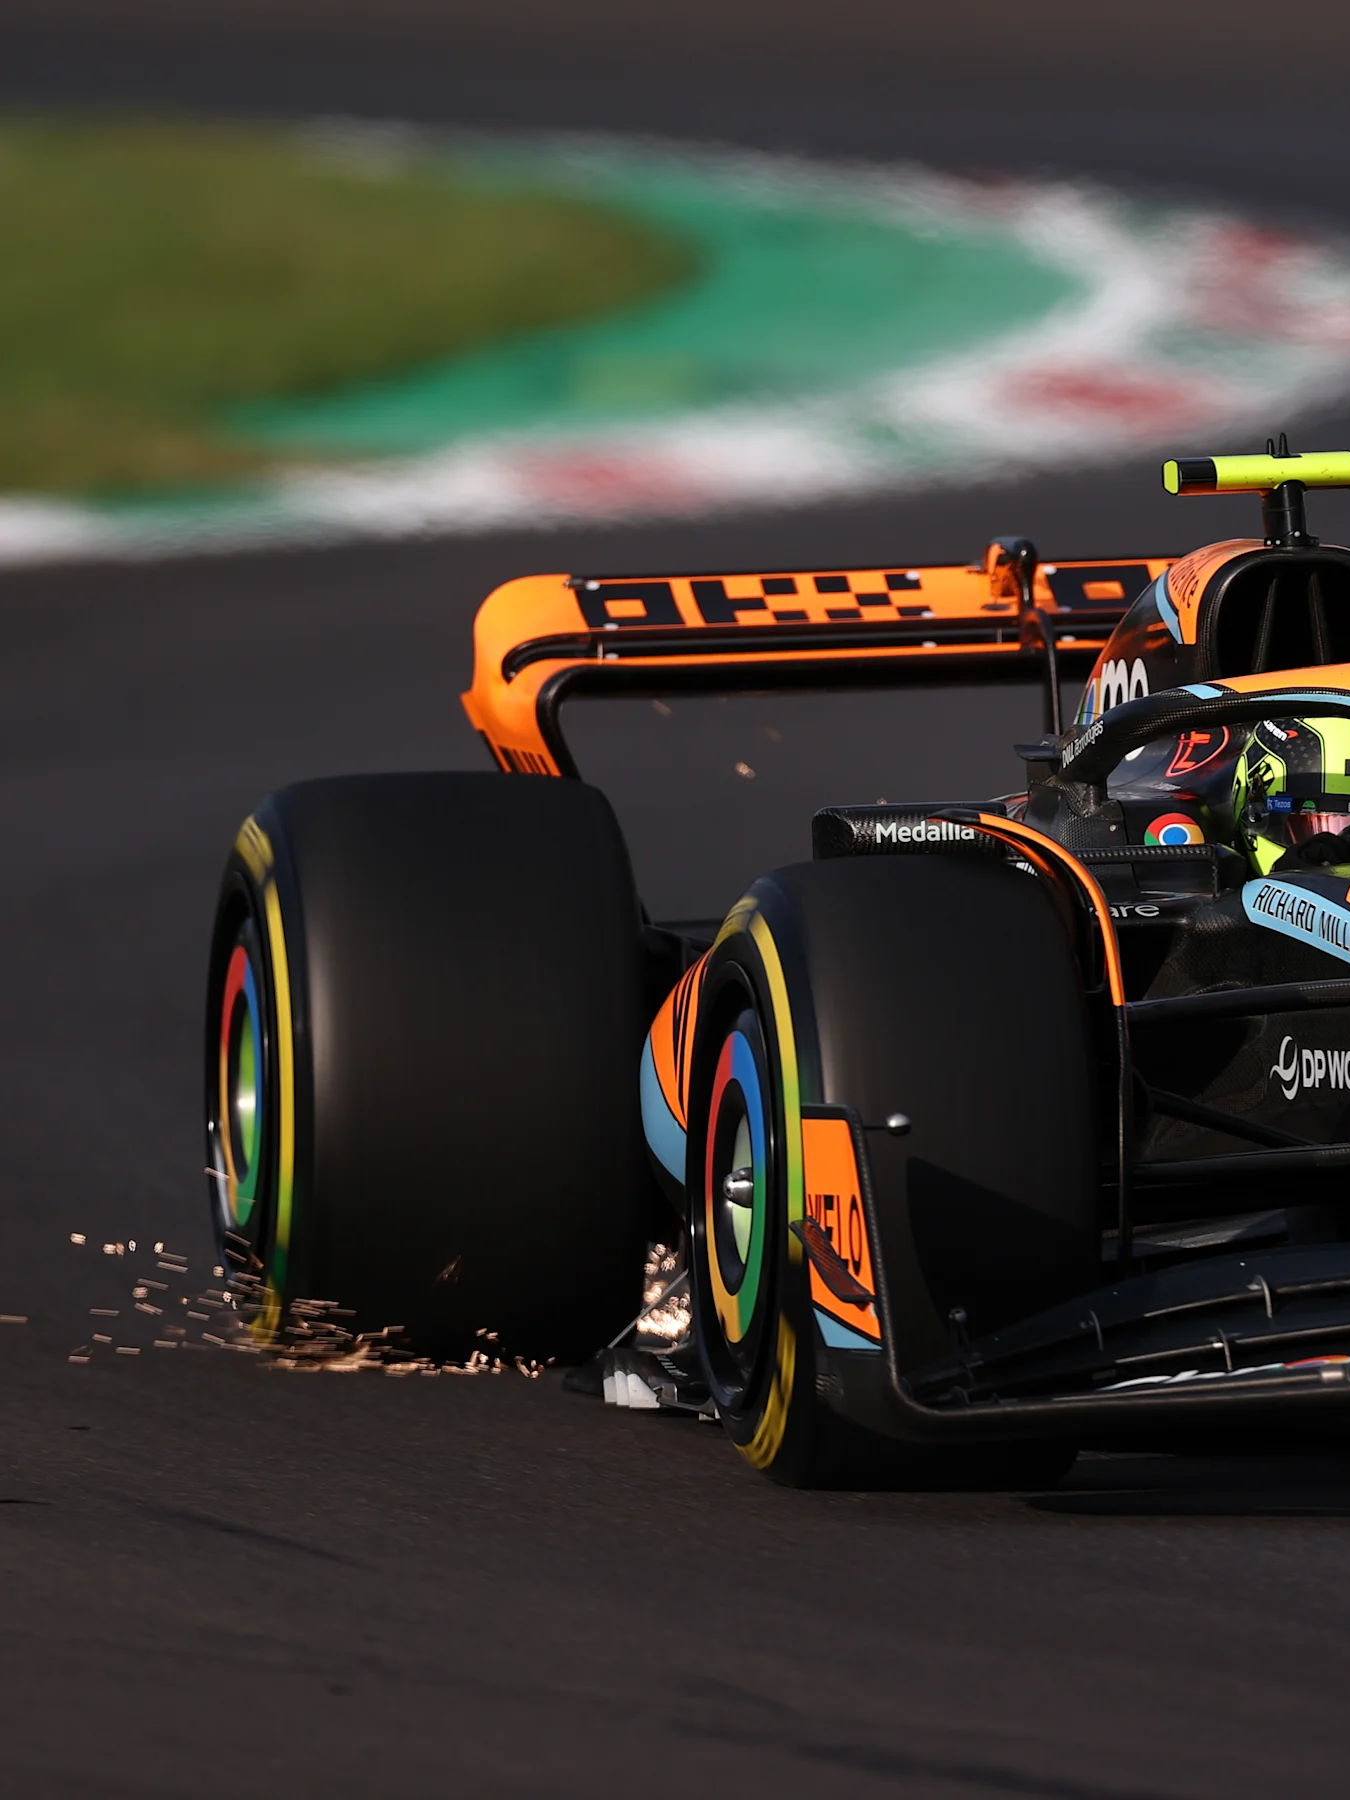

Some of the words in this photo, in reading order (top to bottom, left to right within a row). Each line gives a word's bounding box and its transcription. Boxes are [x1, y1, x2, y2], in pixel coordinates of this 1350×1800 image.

[575, 574, 931, 627] OKX
[1273, 799, 1292, 810] Tezos
[875, 820, 976, 844] Medallia
[1252, 884, 1317, 933] RICHARD
[1301, 1048, 1326, 1089] DP
